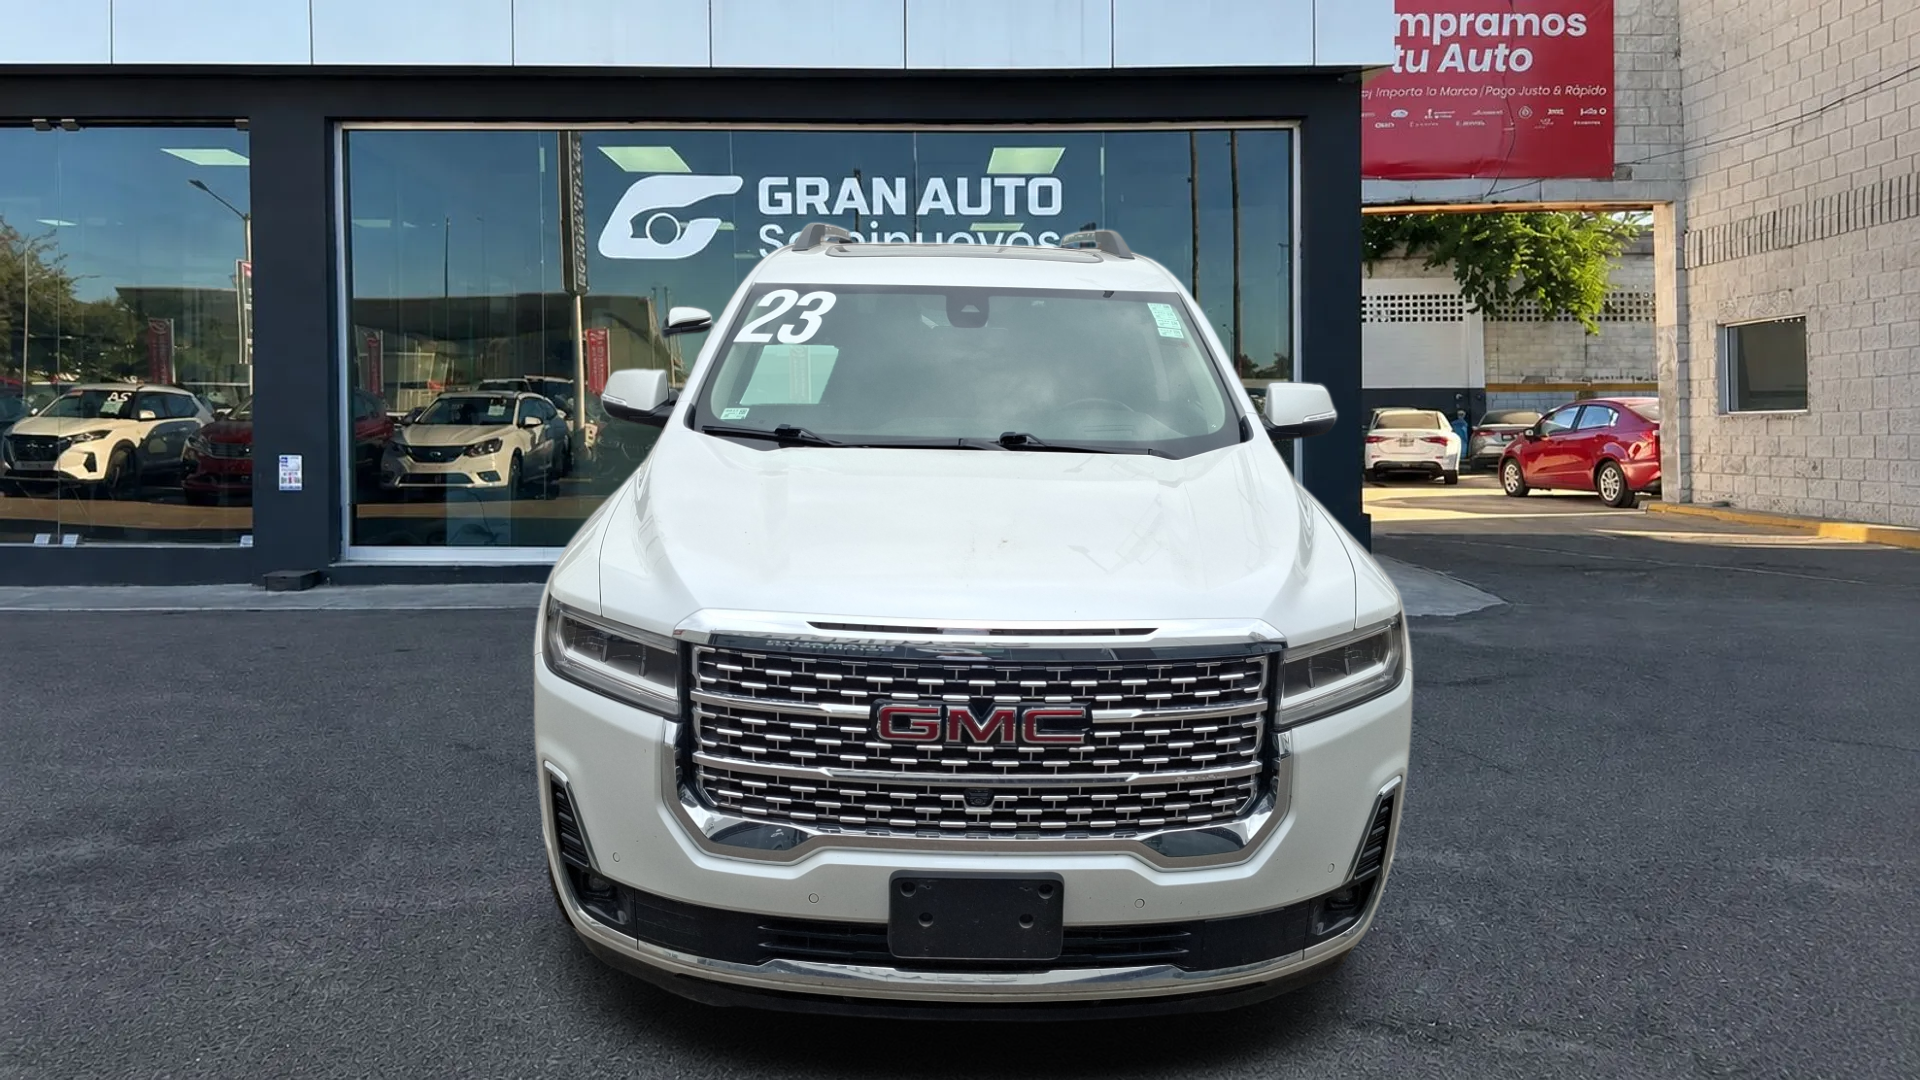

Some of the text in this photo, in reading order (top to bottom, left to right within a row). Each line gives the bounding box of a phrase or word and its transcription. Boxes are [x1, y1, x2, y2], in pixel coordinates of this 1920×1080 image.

[1394, 12, 1587, 45] mpramos
[1392, 43, 1533, 73] tu Auto
[1375, 87, 1423, 99] Importa
[1426, 86, 1437, 97] la
[1439, 86, 1478, 97] Marca
[1519, 85, 1551, 97] Justo
[1553, 85, 1562, 96] &
[1565, 84, 1607, 99] Rápido
[758, 176, 1063, 216] GRAN AUTO
[733, 289, 837, 344] 23
[877, 705, 1087, 745] GMC
